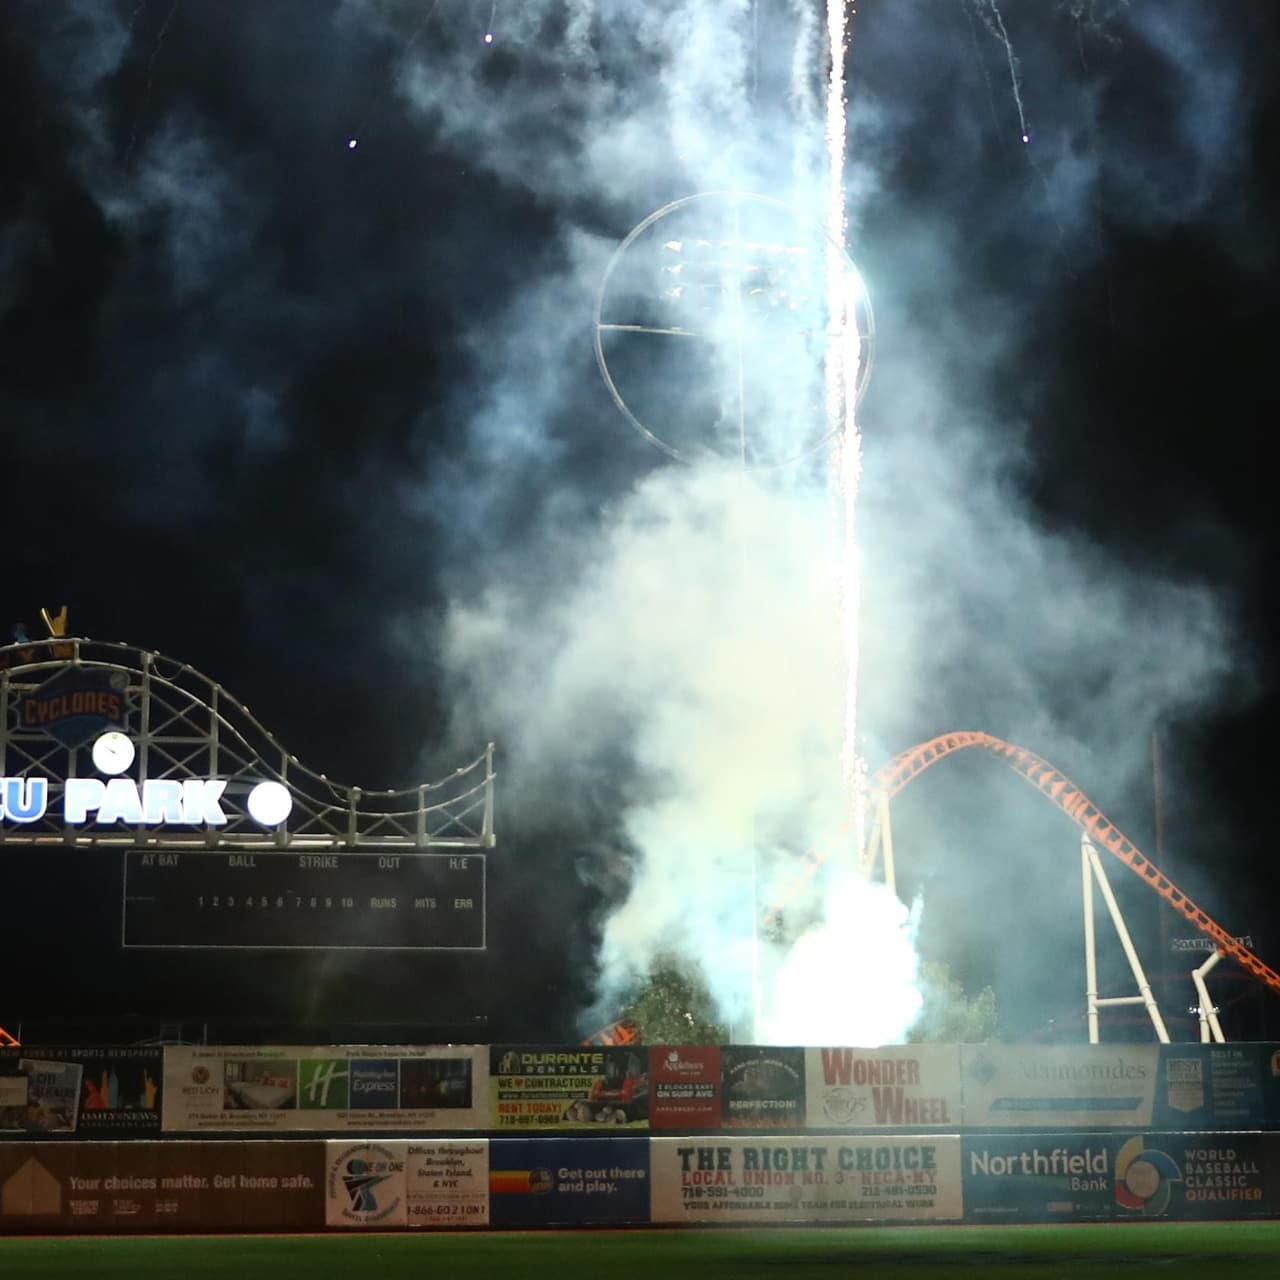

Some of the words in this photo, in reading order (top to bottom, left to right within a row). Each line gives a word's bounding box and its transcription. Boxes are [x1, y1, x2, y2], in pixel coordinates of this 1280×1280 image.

[24, 691, 121, 723] CYCLONES
[65, 777, 228, 824] PARK
[141, 854, 156, 866] AT
[158, 854, 180, 866] BAT
[228, 855, 257, 867] BALL
[298, 855, 339, 868] STRIKE
[378, 856, 401, 869] OUT
[449, 857, 468, 869] H/E
[370, 897, 397, 908] RUNS
[414, 898, 437, 909] HITS
[454, 898, 473, 909] ERR
[71, 1048, 105, 1057] SPORTS
[107, 1048, 160, 1057] NEWSPAPER
[521, 1052, 604, 1065] DURANTE
[526, 1065, 600, 1073] RENTALS
[352, 1079, 398, 1093] Express
[498, 1078, 513, 1088] WE
[524, 1078, 593, 1088] CONTRACTORS
[656, 1090, 671, 1098] ON
[671, 1090, 694, 1098] SURF
[498, 1103, 523, 1113] RENT
[527, 1103, 562, 1113] TODAY!
[729, 1100, 797, 1109] PERFECTION!
[80, 1112, 114, 1121] DAILY
[122, 1112, 159, 1121] NEWS
[407, 1147, 436, 1155] Offices
[1184, 1149, 1236, 1161] WORLD
[677, 1147, 732, 1171] THE
[743, 1147, 828, 1171] RIGHT
[838, 1146, 937, 1170] CHOICE
[970, 1148, 1108, 1176] Northfield
[388, 1161, 404, 1172] ONE
[557, 1167, 583, 1179] Get
[584, 1169, 608, 1179] out
[609, 1166, 646, 1179] there
[1185, 1163, 1260, 1174] BASEBALL
[69, 1175, 100, 1190] Your
[104, 1175, 157, 1190] choices
[161, 1175, 210, 1190] matter.
[213, 1174, 237, 1189] Get
[239, 1174, 278, 1189] home
[280, 1174, 315, 1189] safe.
[441, 1180, 459, 1188] NYC
[681, 1171, 736, 1186] LOCAL
[743, 1171, 796, 1185] UNION
[802, 1171, 830, 1185] NO.
[834, 1171, 845, 1185] 3
[861, 1171, 937, 1184] NECA-NY
[1071, 1176, 1108, 1192] Bank
[1185, 1176, 1248, 1187] CLASSIC
[557, 1180, 584, 1192] and
[585, 1180, 618, 1195] play.
[1185, 1188, 1264, 1201] QUALIFIER
[801, 1200, 829, 1209] TEAM
[905, 1199, 935, 1208] WORK
